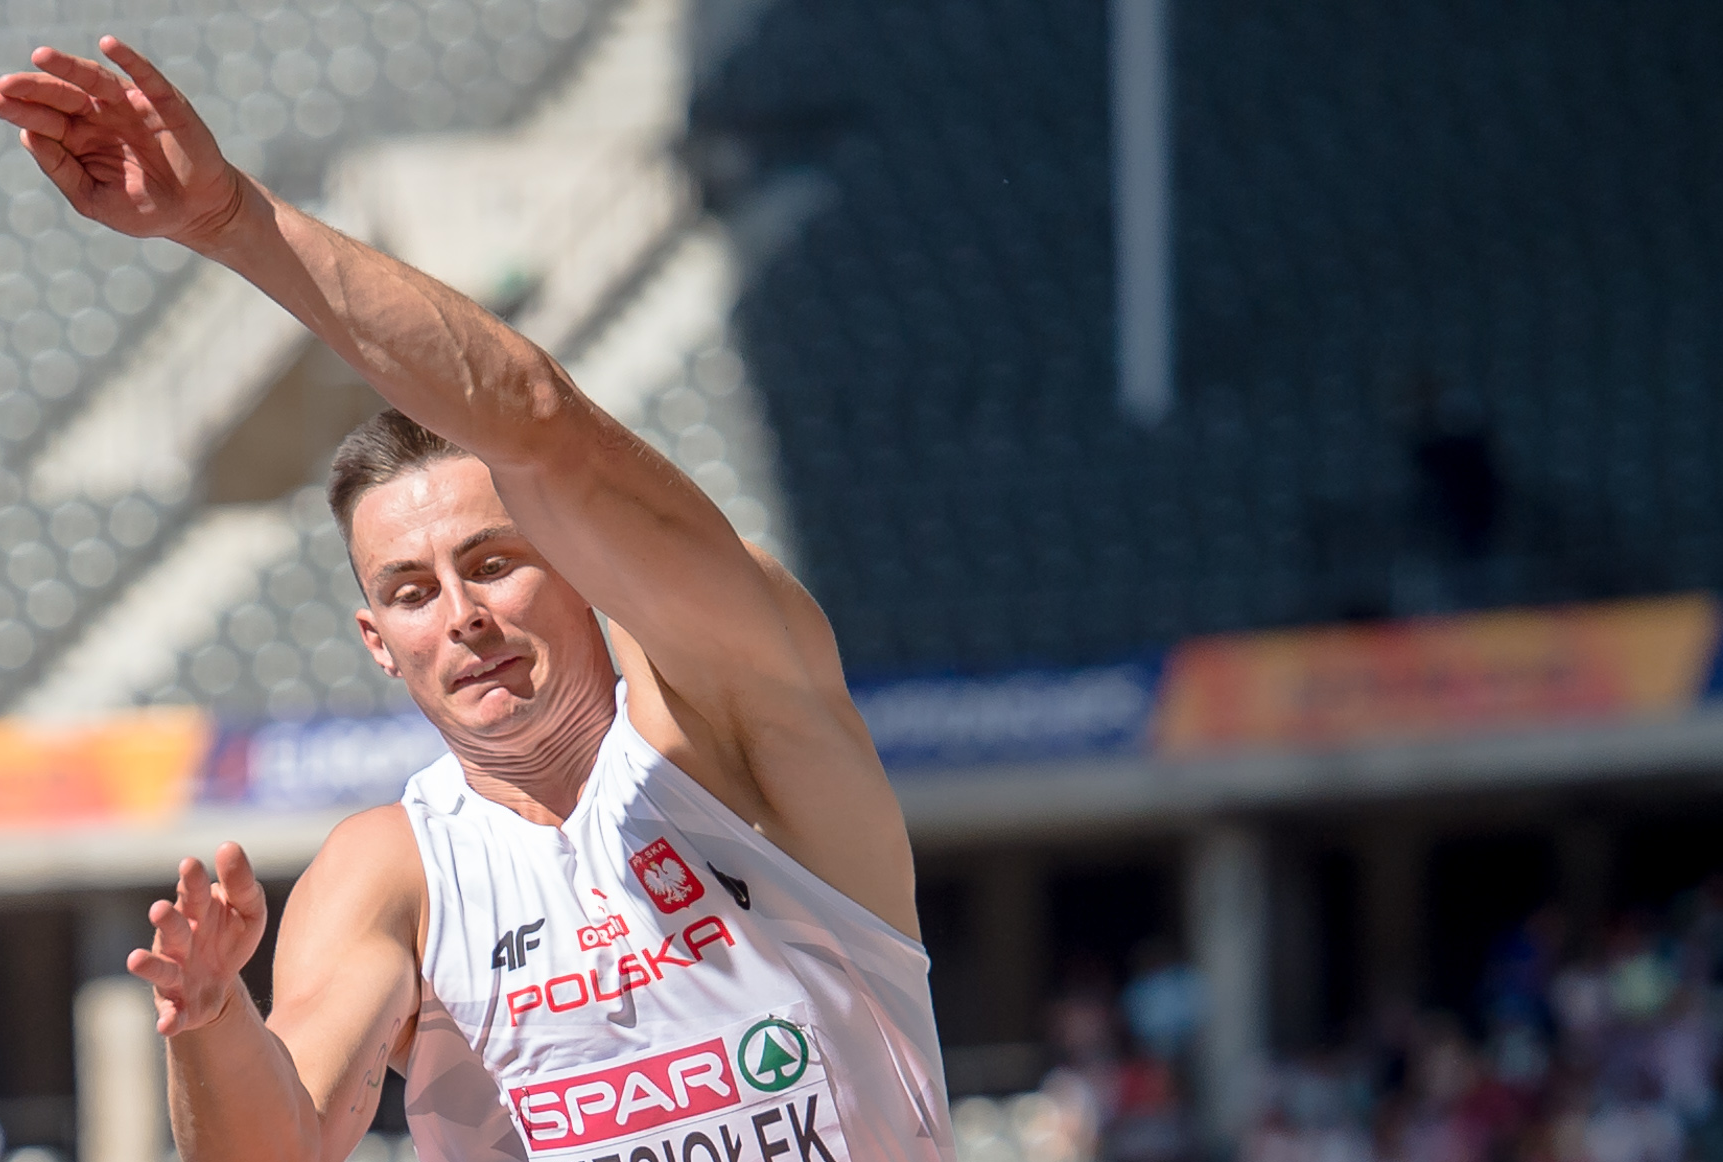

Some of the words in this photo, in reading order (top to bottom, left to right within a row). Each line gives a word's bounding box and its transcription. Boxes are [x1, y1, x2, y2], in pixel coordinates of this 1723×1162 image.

[632, 842, 667, 868] PSKA
[506, 915, 736, 1027] POLSKA
[521, 1051, 731, 1141] SPAR
